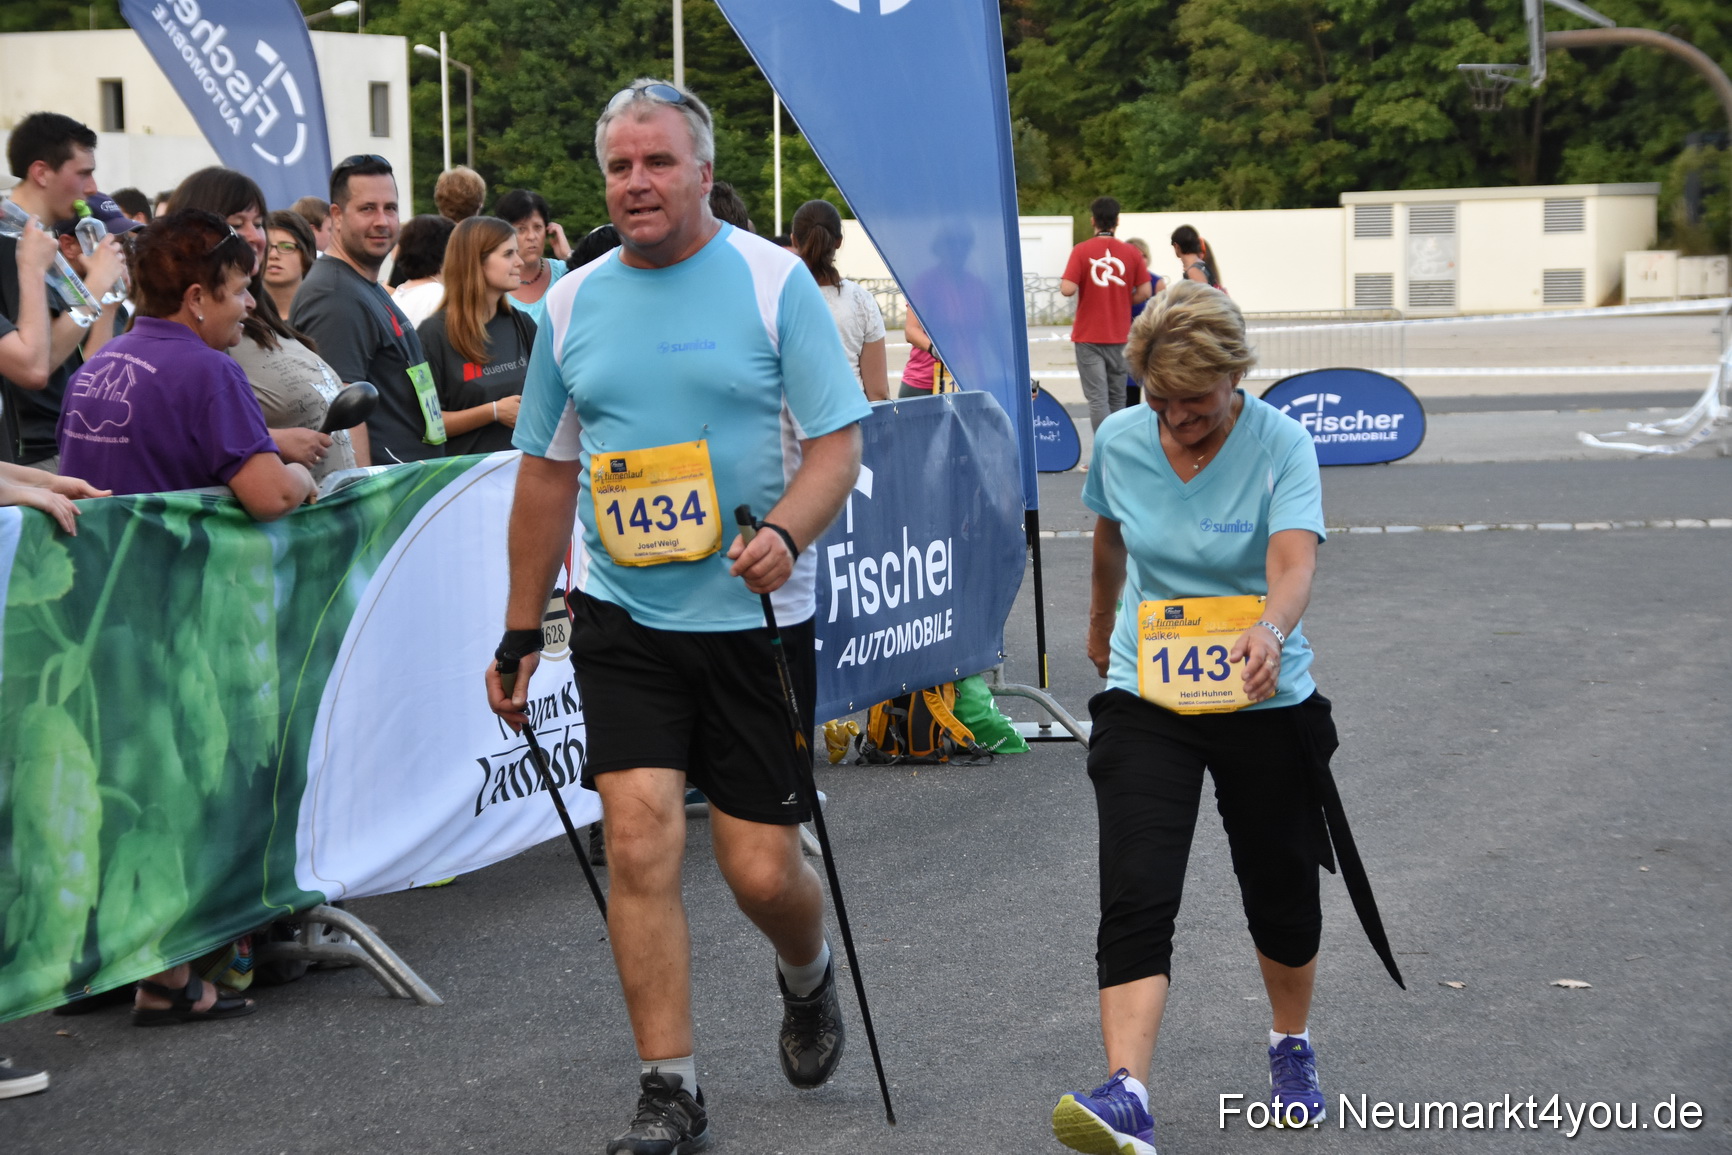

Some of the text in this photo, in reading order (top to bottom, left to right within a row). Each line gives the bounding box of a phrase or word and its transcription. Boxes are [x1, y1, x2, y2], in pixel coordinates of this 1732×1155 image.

[671, 339, 716, 352] sumida
[1301, 409, 1405, 432] Fischer
[1313, 431, 1398, 443] AUTOMOBILE
[605, 469, 643, 480] firmenlauf
[606, 490, 707, 535] 1434
[1212, 519, 1254, 533] sumida
[637, 538, 679, 550] Josef Weigl
[1156, 617, 1202, 627] firmenlauf
[837, 608, 952, 669] AUTOMOBILE
[1152, 644, 1250, 684] 143
[1180, 689, 1233, 698] Heidi Huhnen
